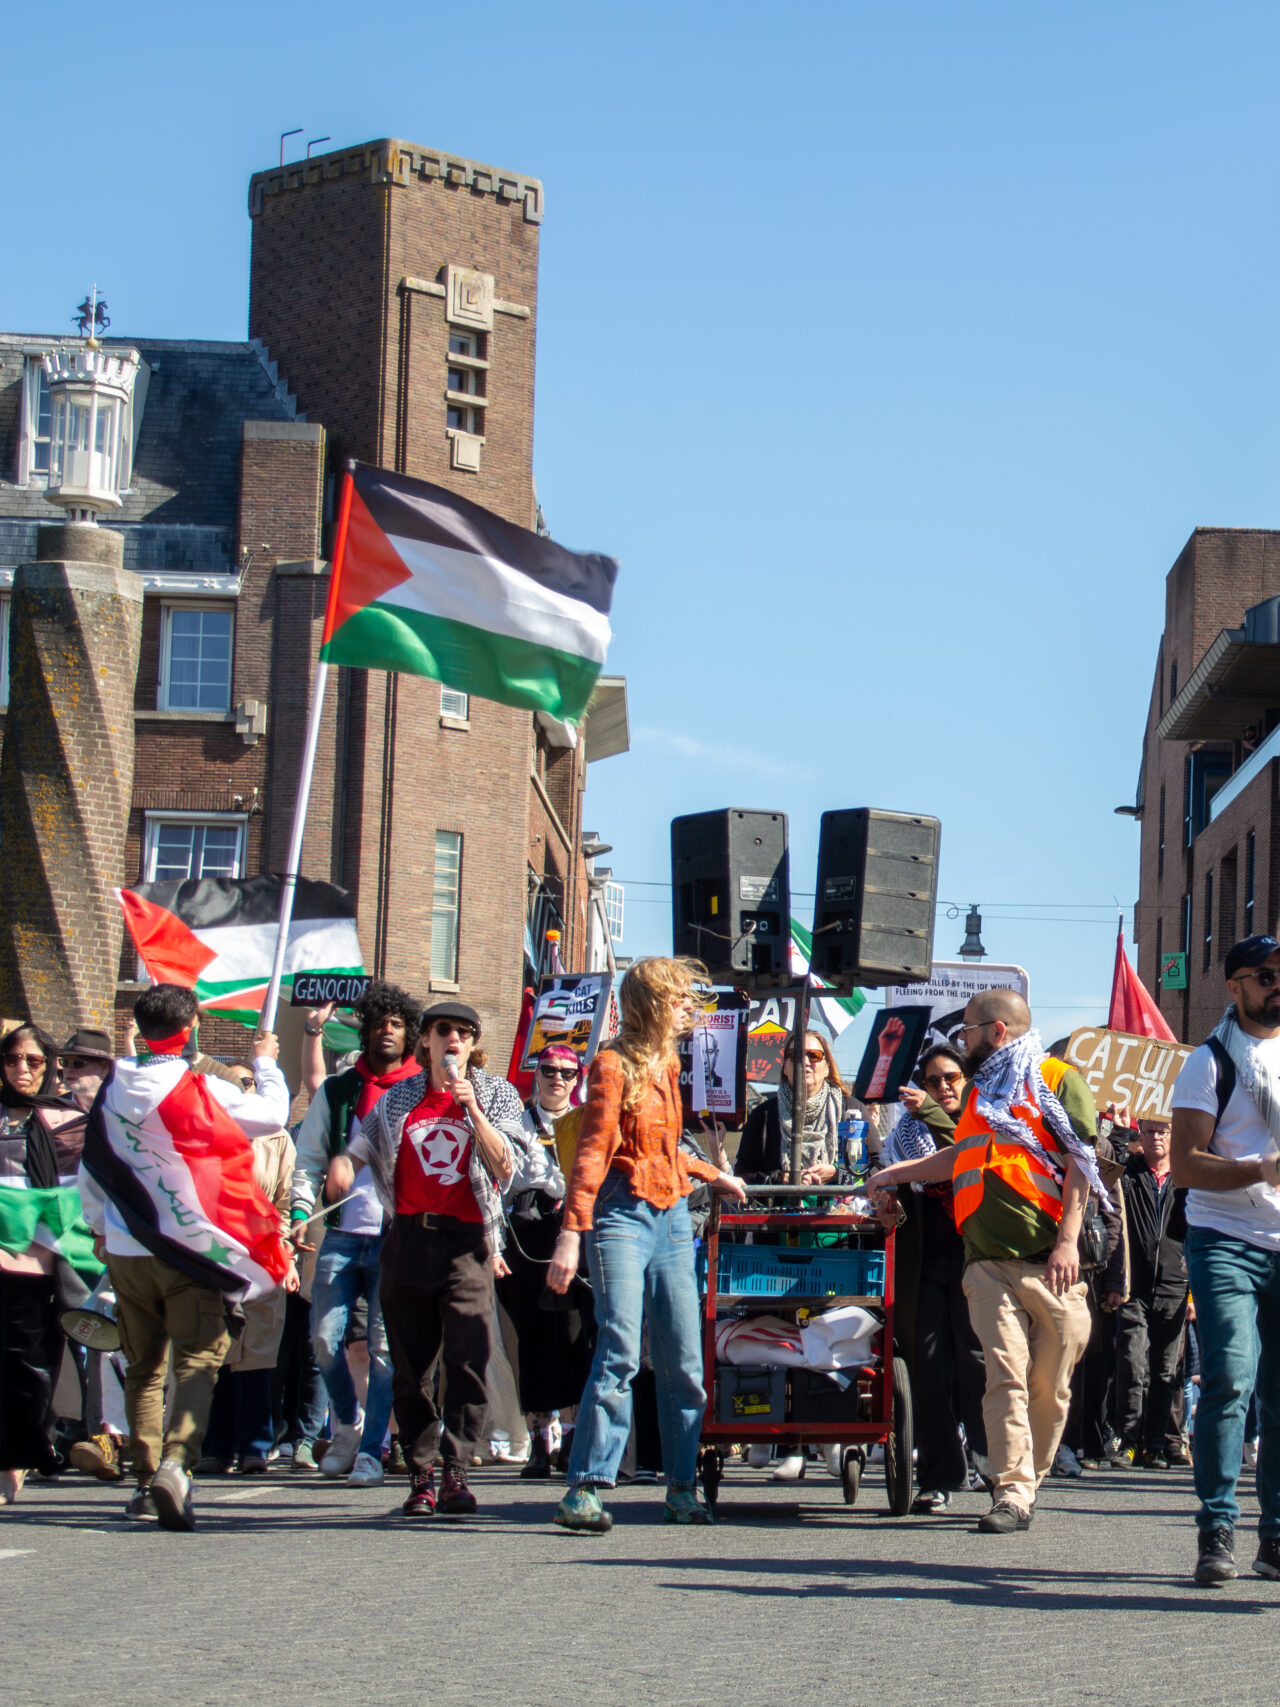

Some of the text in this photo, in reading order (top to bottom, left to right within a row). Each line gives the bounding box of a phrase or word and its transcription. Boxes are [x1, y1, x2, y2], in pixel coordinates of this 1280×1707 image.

[575, 984, 592, 998] CAT
[927, 979, 950, 987] KILLED
[951, 980, 960, 988] BY
[963, 981, 975, 989] THE
[896, 988, 923, 996] FLEEING
[925, 988, 944, 996] FROM
[961, 990, 976, 999] ISRA
[565, 999, 594, 1016] KILLS
[1070, 1031, 1193, 1083] CAT UIT
[1106, 1073, 1175, 1118] STAL
